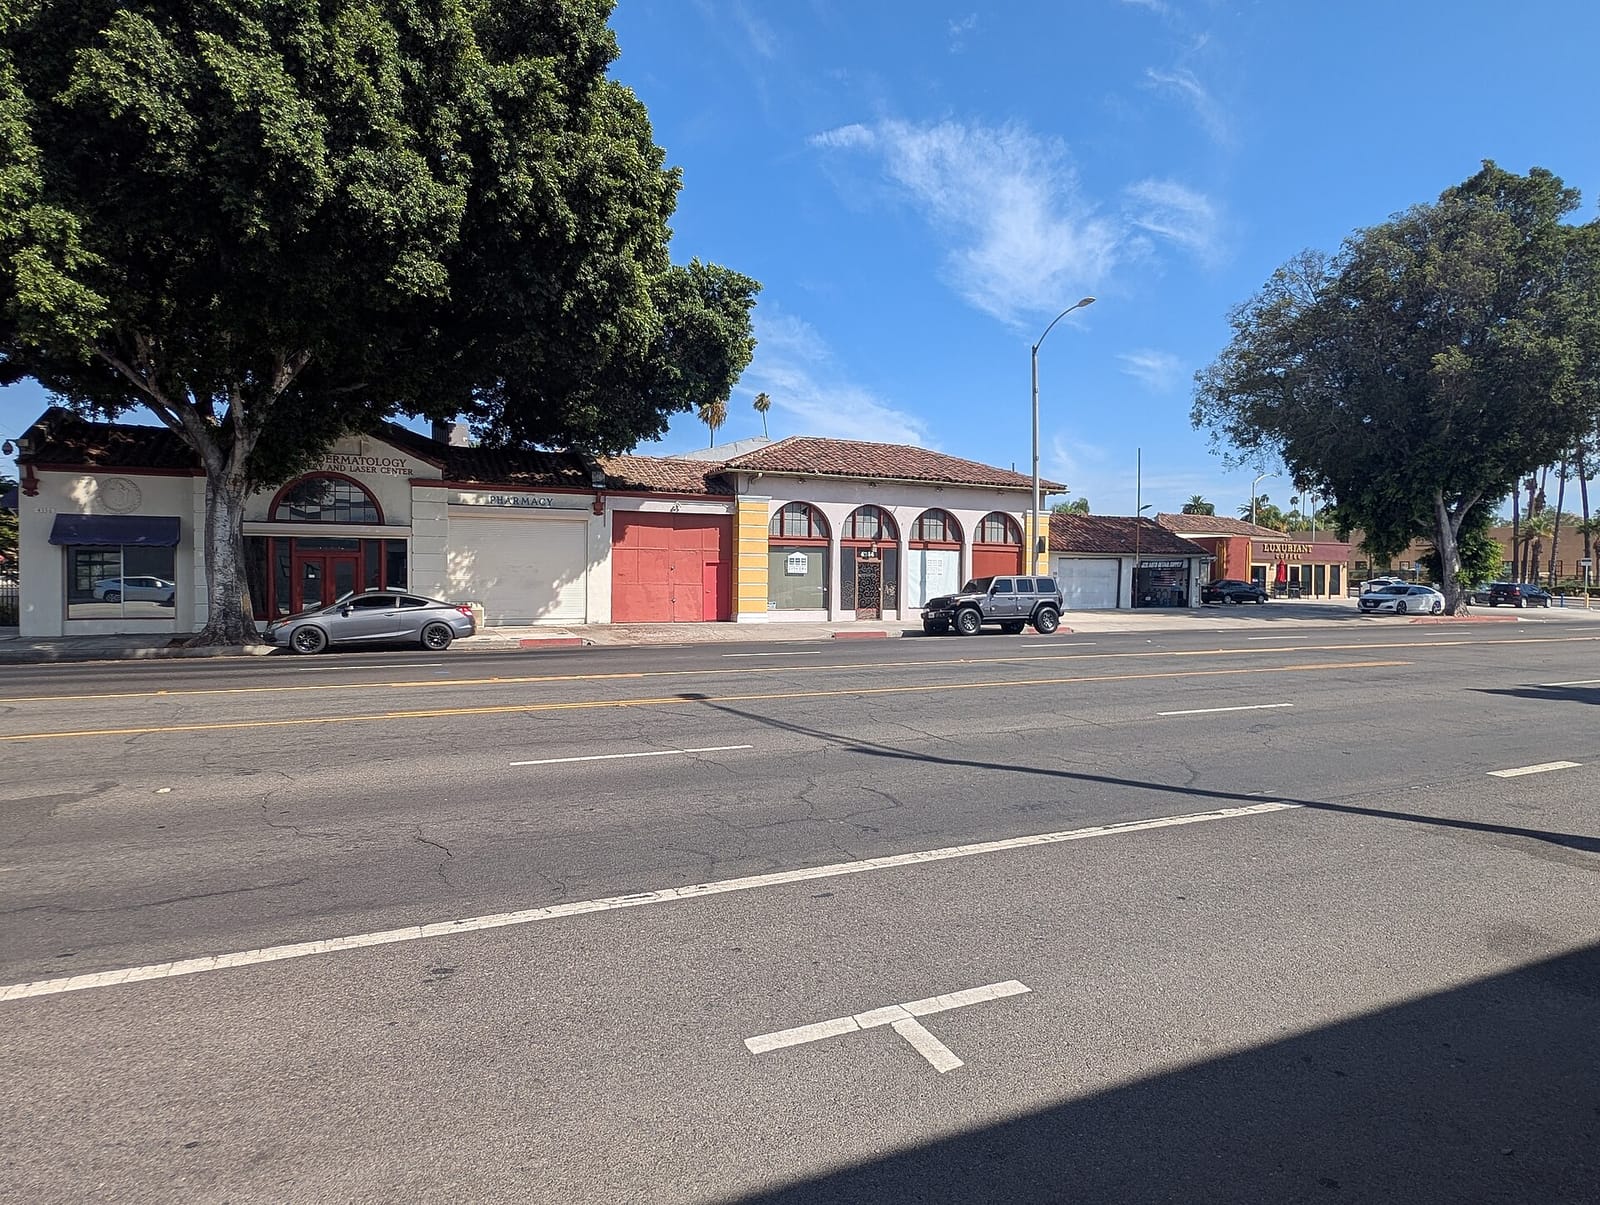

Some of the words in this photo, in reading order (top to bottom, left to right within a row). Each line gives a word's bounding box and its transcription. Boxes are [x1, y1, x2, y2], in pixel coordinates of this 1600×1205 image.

[326, 463, 347, 472] AND
[350, 465, 377, 474] LASER
[380, 467, 414, 476] CENTER
[489, 495, 554, 506] PHARMACY
[1263, 543, 1313, 553] LUXURIANT
